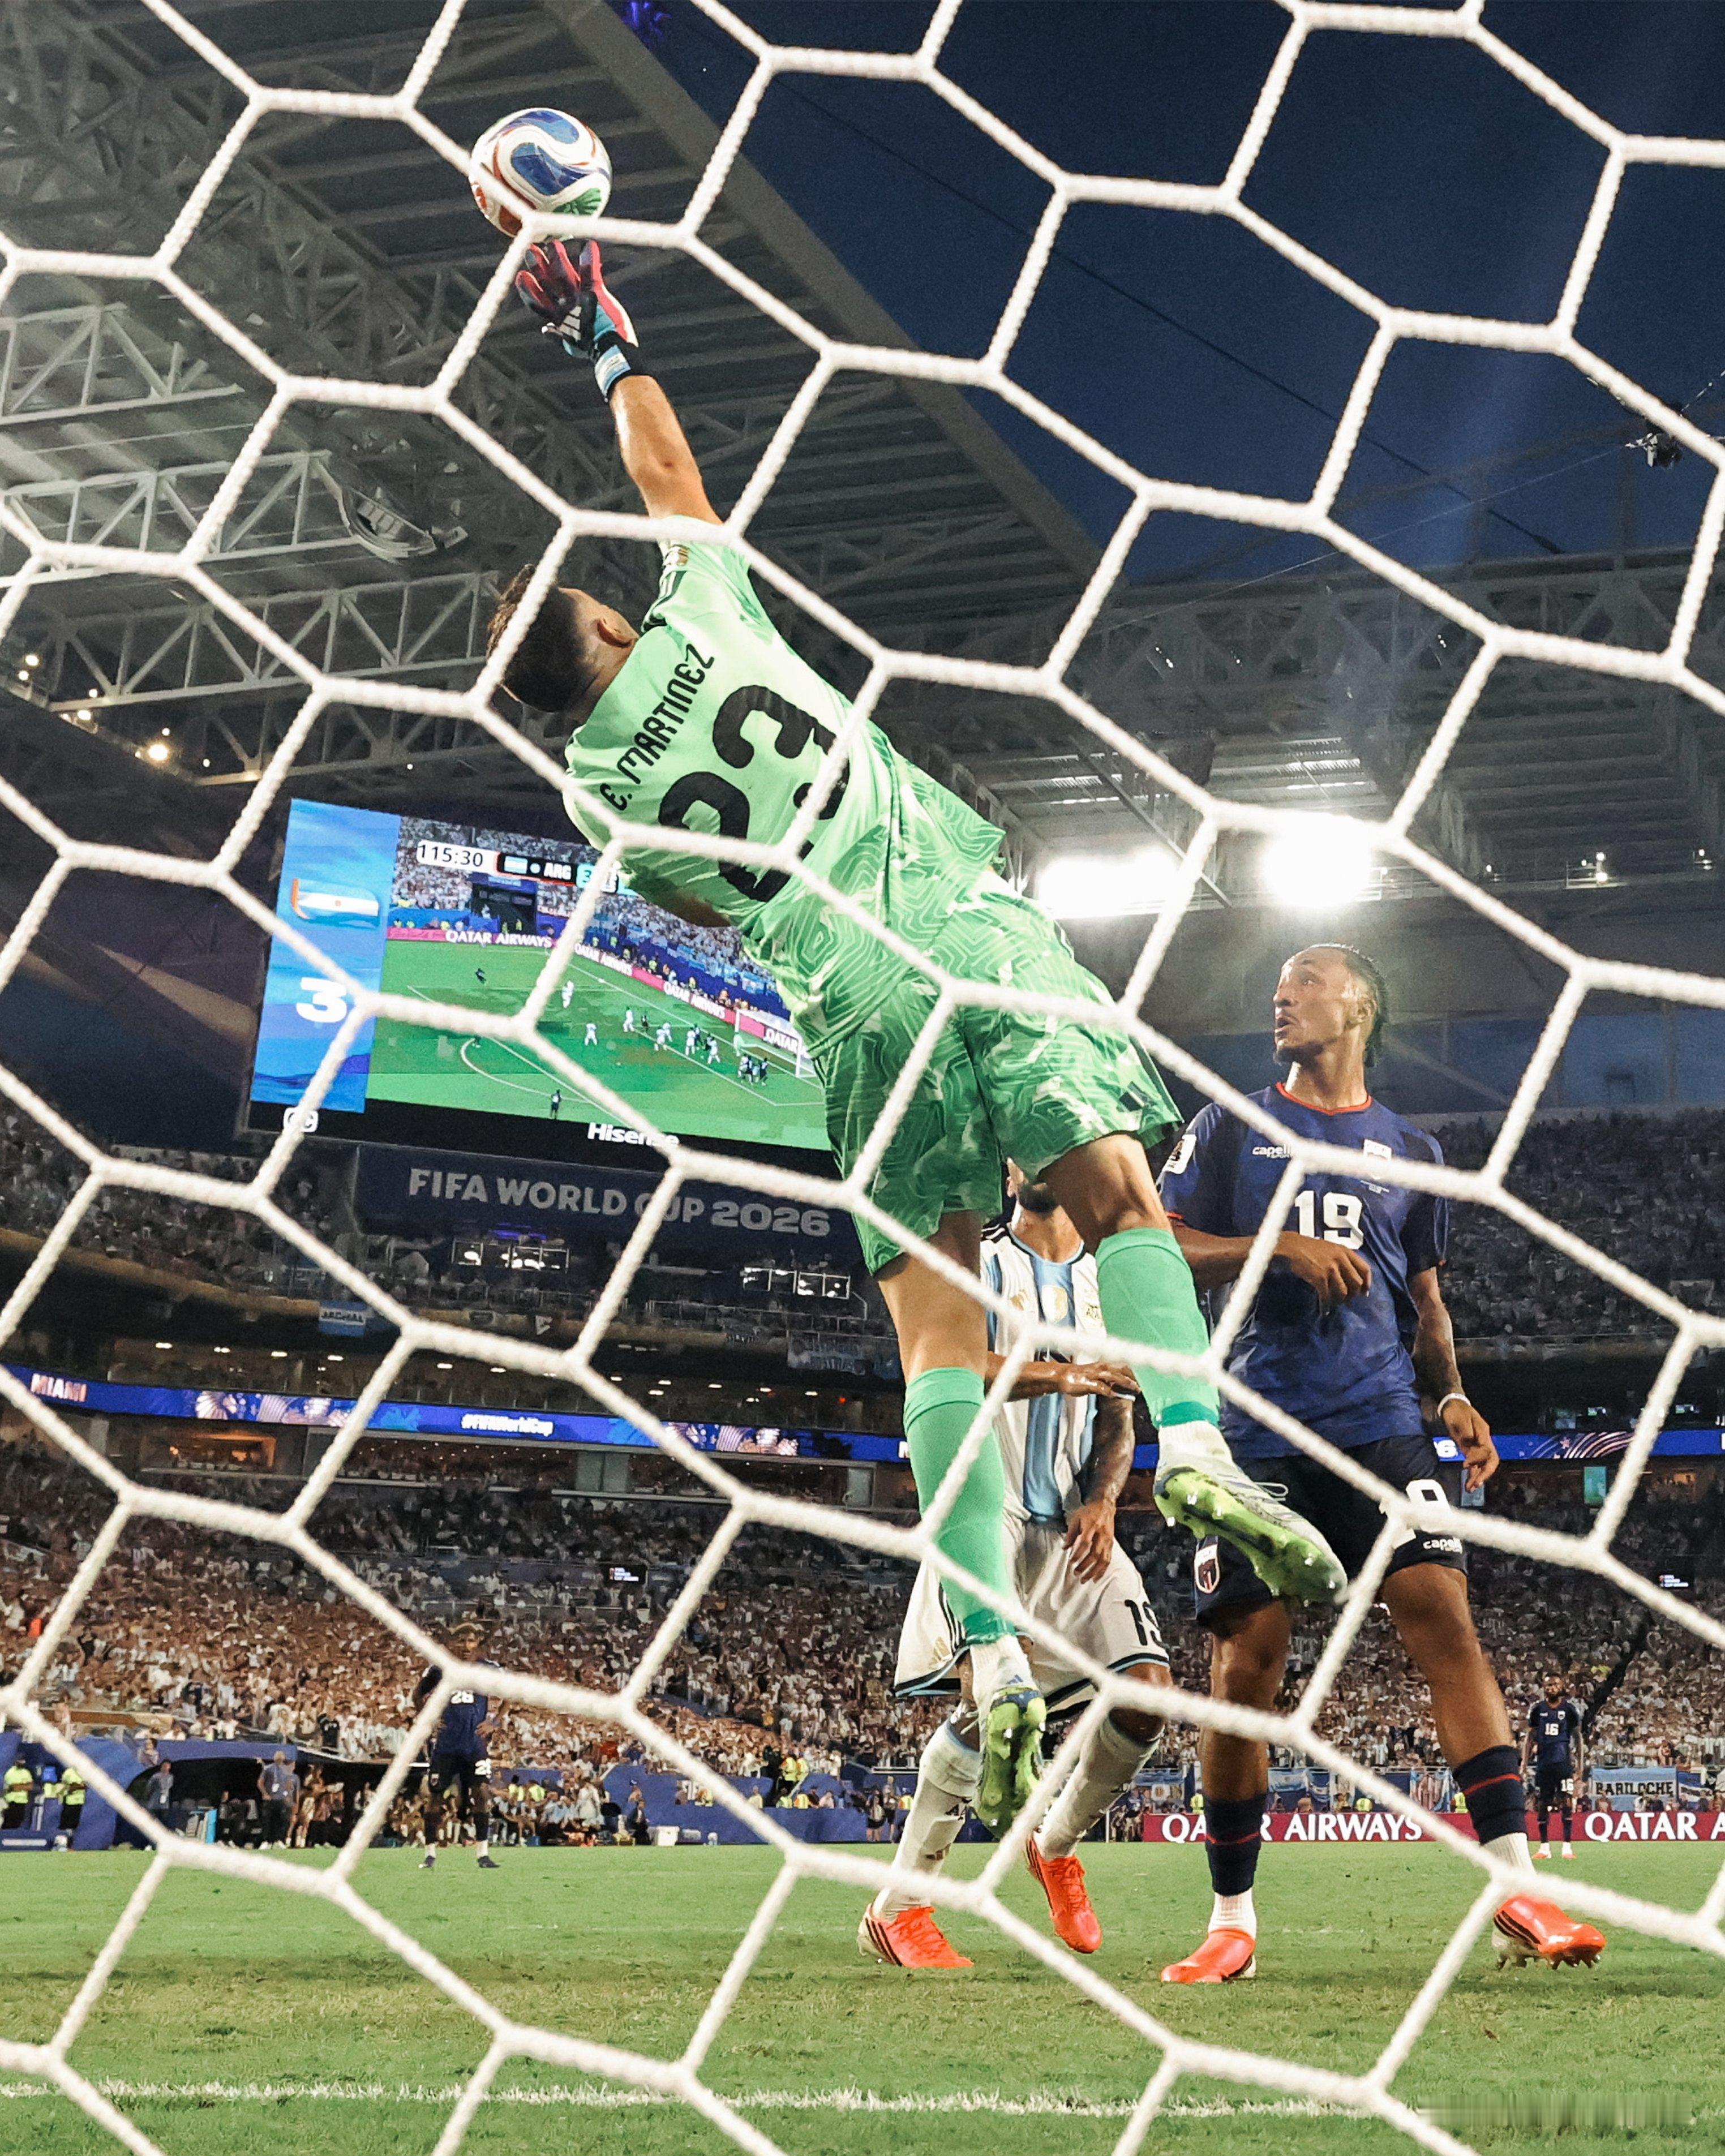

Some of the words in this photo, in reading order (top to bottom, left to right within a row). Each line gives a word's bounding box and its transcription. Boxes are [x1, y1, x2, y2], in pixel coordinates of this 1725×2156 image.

[599, 782, 633, 811] E.
[616, 643, 715, 784] MARTINEZ
[658, 685, 849, 903] 23
[419, 844, 483, 867] 115:30
[543, 862, 572, 880] ARG
[445, 929, 492, 944] QATAR
[495, 933, 552, 948] AIRWAYS
[295, 977, 347, 1023] 3
[587, 1122, 679, 1146] Hisene
[409, 1169, 488, 1202] FIFA
[497, 1178, 627, 1216] WORLD
[633, 1192, 705, 1223] CUP
[711, 1201, 830, 1238] 2026
[1295, 1190, 1364, 1249] 19
[31, 1373, 87, 1402] MIAMI
[1544, 1723, 1559, 1736] 16
[1560, 1778, 1574, 1792] 16
[1595, 1781, 1673, 1798] BARILOCHE
[1162, 1814, 1272, 1844] QAR
[1284, 1814, 1423, 1841] AIRWAYS
[1585, 1812, 1698, 1843] QATAR
